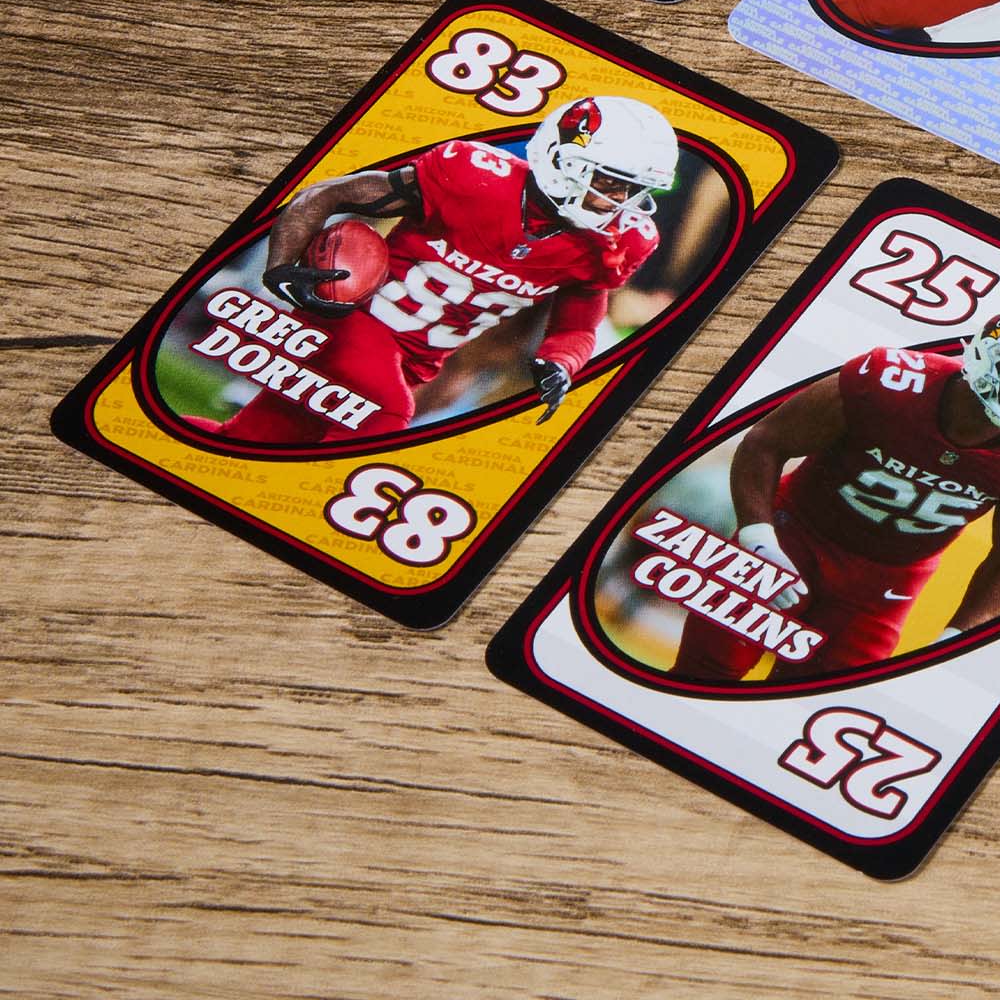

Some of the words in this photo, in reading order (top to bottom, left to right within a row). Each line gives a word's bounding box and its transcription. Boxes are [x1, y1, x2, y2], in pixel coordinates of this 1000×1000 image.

[429, 29, 564, 115] 83
[354, 127, 424, 144] DINALS
[381, 108, 485, 131] CARDINALS
[404, 104, 466, 119] ARIZONA
[426, 238, 560, 297] ARIZONA
[850, 230, 1000, 326] 25
[206, 289, 330, 359] GREG
[368, 259, 535, 349] 83
[190, 324, 383, 432] DORTCH
[158, 458, 269, 484] CARDINALS
[184, 453, 249, 470] ARIZONA
[431, 451, 530, 476] CARDINAL
[457, 446, 522, 463] ARIZONA
[230, 496, 325, 520] CARDINA
[326, 464, 475, 567] 83
[838, 469, 986, 534] 25
[634, 508, 797, 601] ZAVEN
[633, 554, 825, 661] COLLINS
[778, 706, 942, 820] 25
